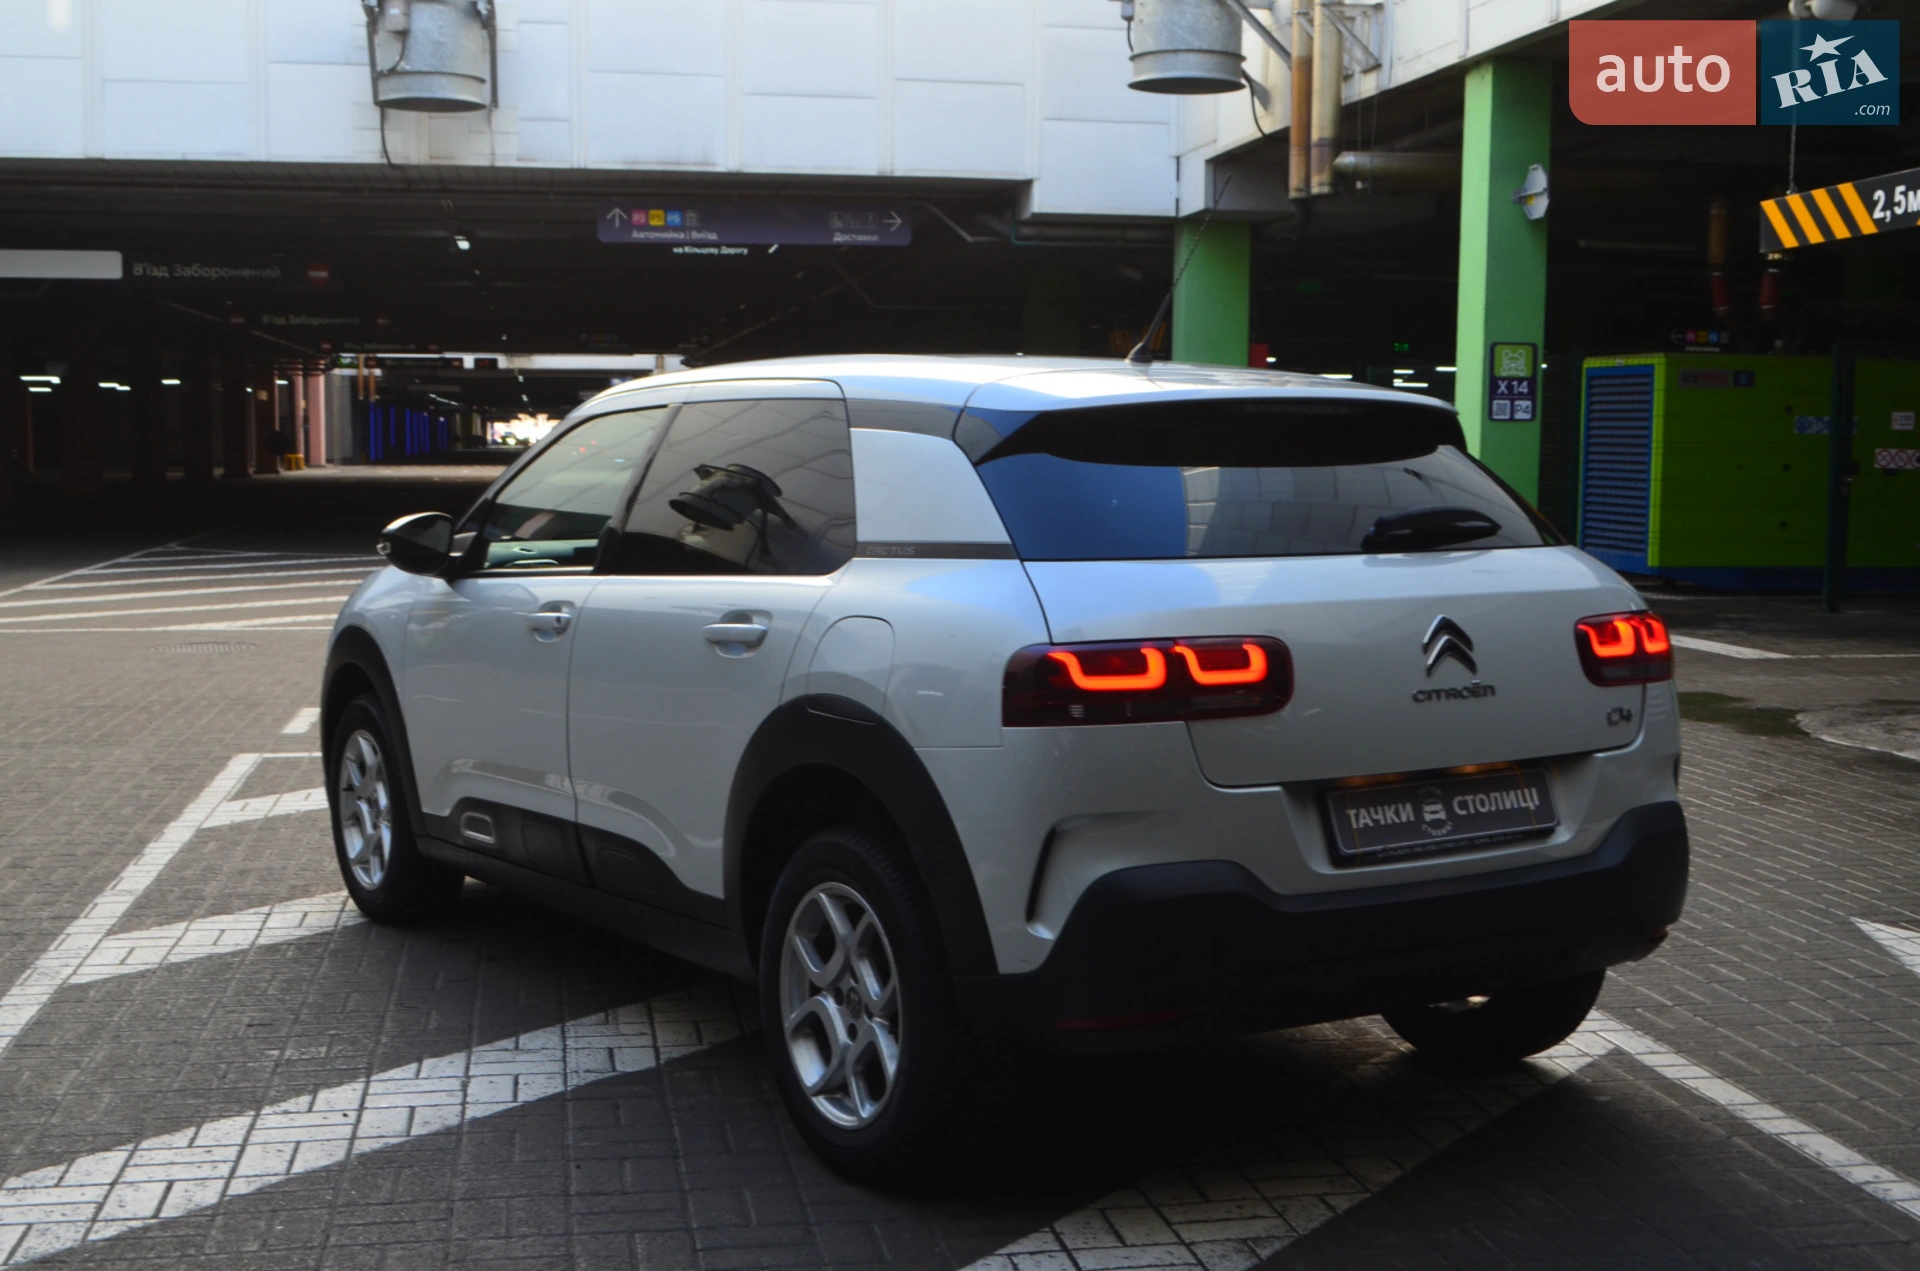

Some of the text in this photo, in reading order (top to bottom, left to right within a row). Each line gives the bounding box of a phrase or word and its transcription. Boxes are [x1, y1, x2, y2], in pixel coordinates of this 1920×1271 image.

[173, 262, 282, 281] Заборонений
[1510, 380, 1529, 395] 14
[1515, 403, 1530, 415] P4
[1412, 681, 1496, 703] CITROËN
[1606, 706, 1633, 727] C4
[1346, 802, 1415, 829] ТАЧКИ
[1452, 786, 1540, 817] СТОЛИЦІ
